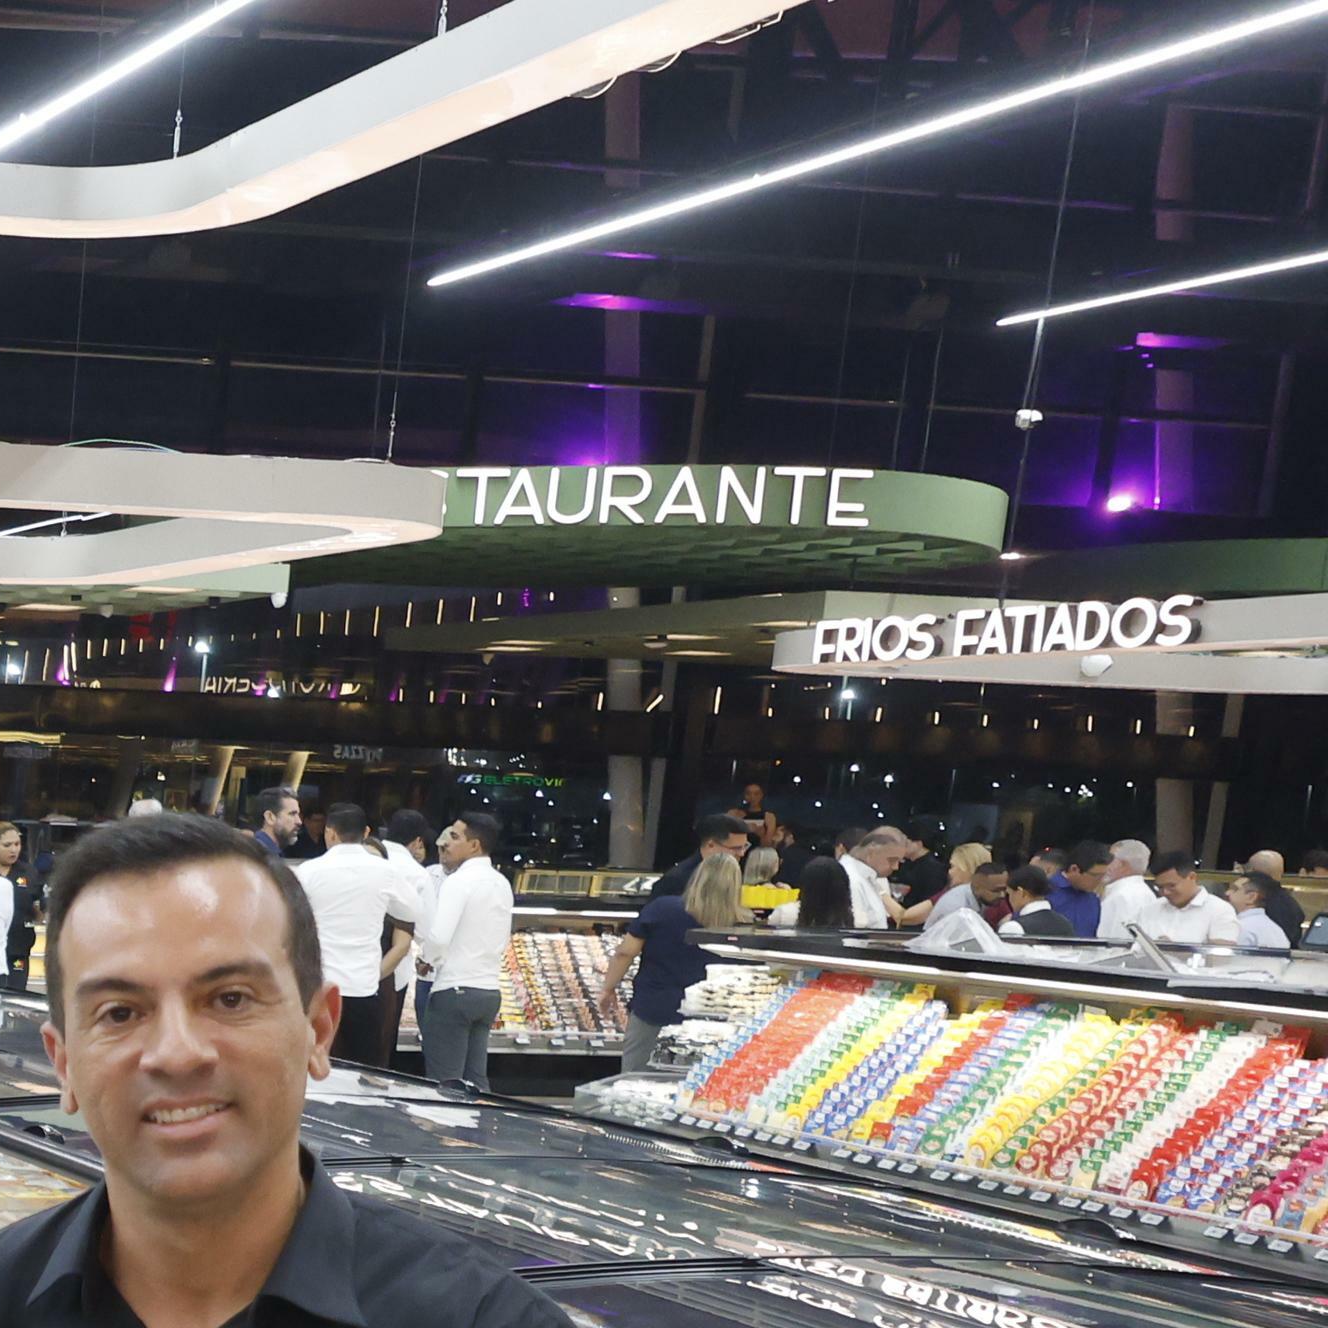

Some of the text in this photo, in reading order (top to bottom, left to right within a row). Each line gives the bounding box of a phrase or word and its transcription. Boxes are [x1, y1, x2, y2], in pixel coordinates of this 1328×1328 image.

[432, 466, 875, 526] TAURANTE
[812, 594, 1196, 664] FRIOS FATIADOS
